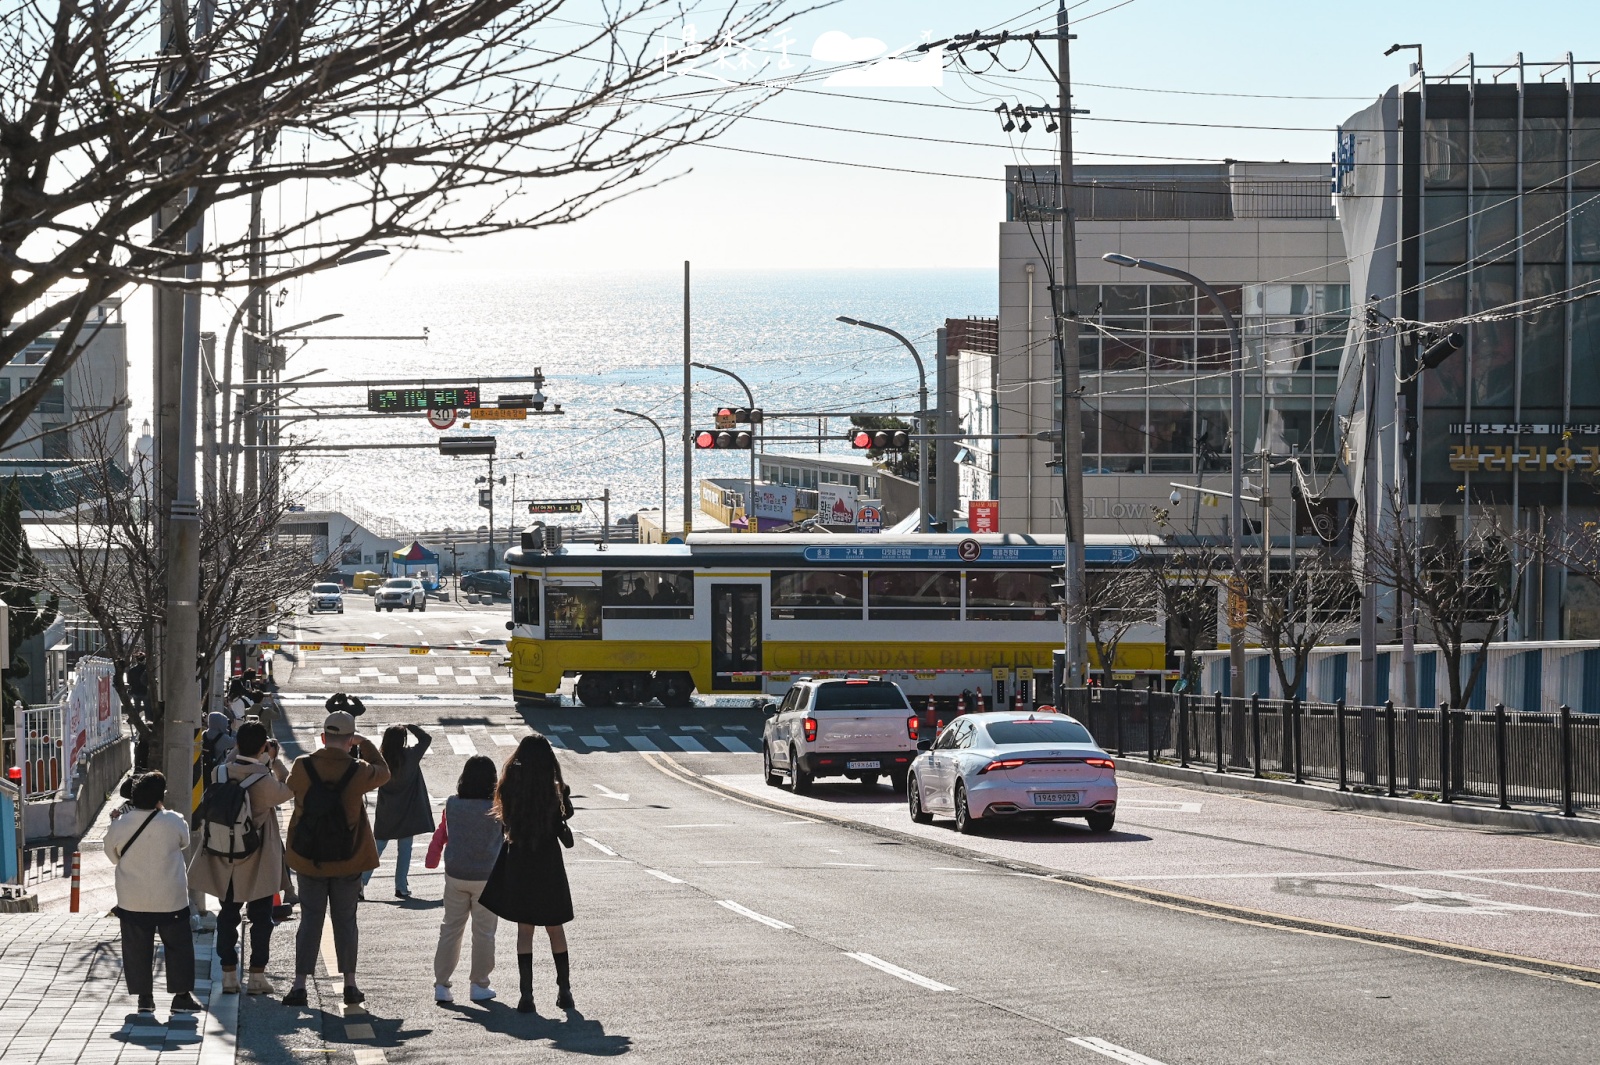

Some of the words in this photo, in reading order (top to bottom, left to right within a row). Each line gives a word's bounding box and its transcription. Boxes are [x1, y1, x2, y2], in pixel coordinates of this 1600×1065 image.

[432, 409, 450, 419] 30
[799, 649, 925, 665] HAEUNDAE
[940, 650, 1048, 666] BLUELINE
[1058, 794, 1077, 802] 9023
